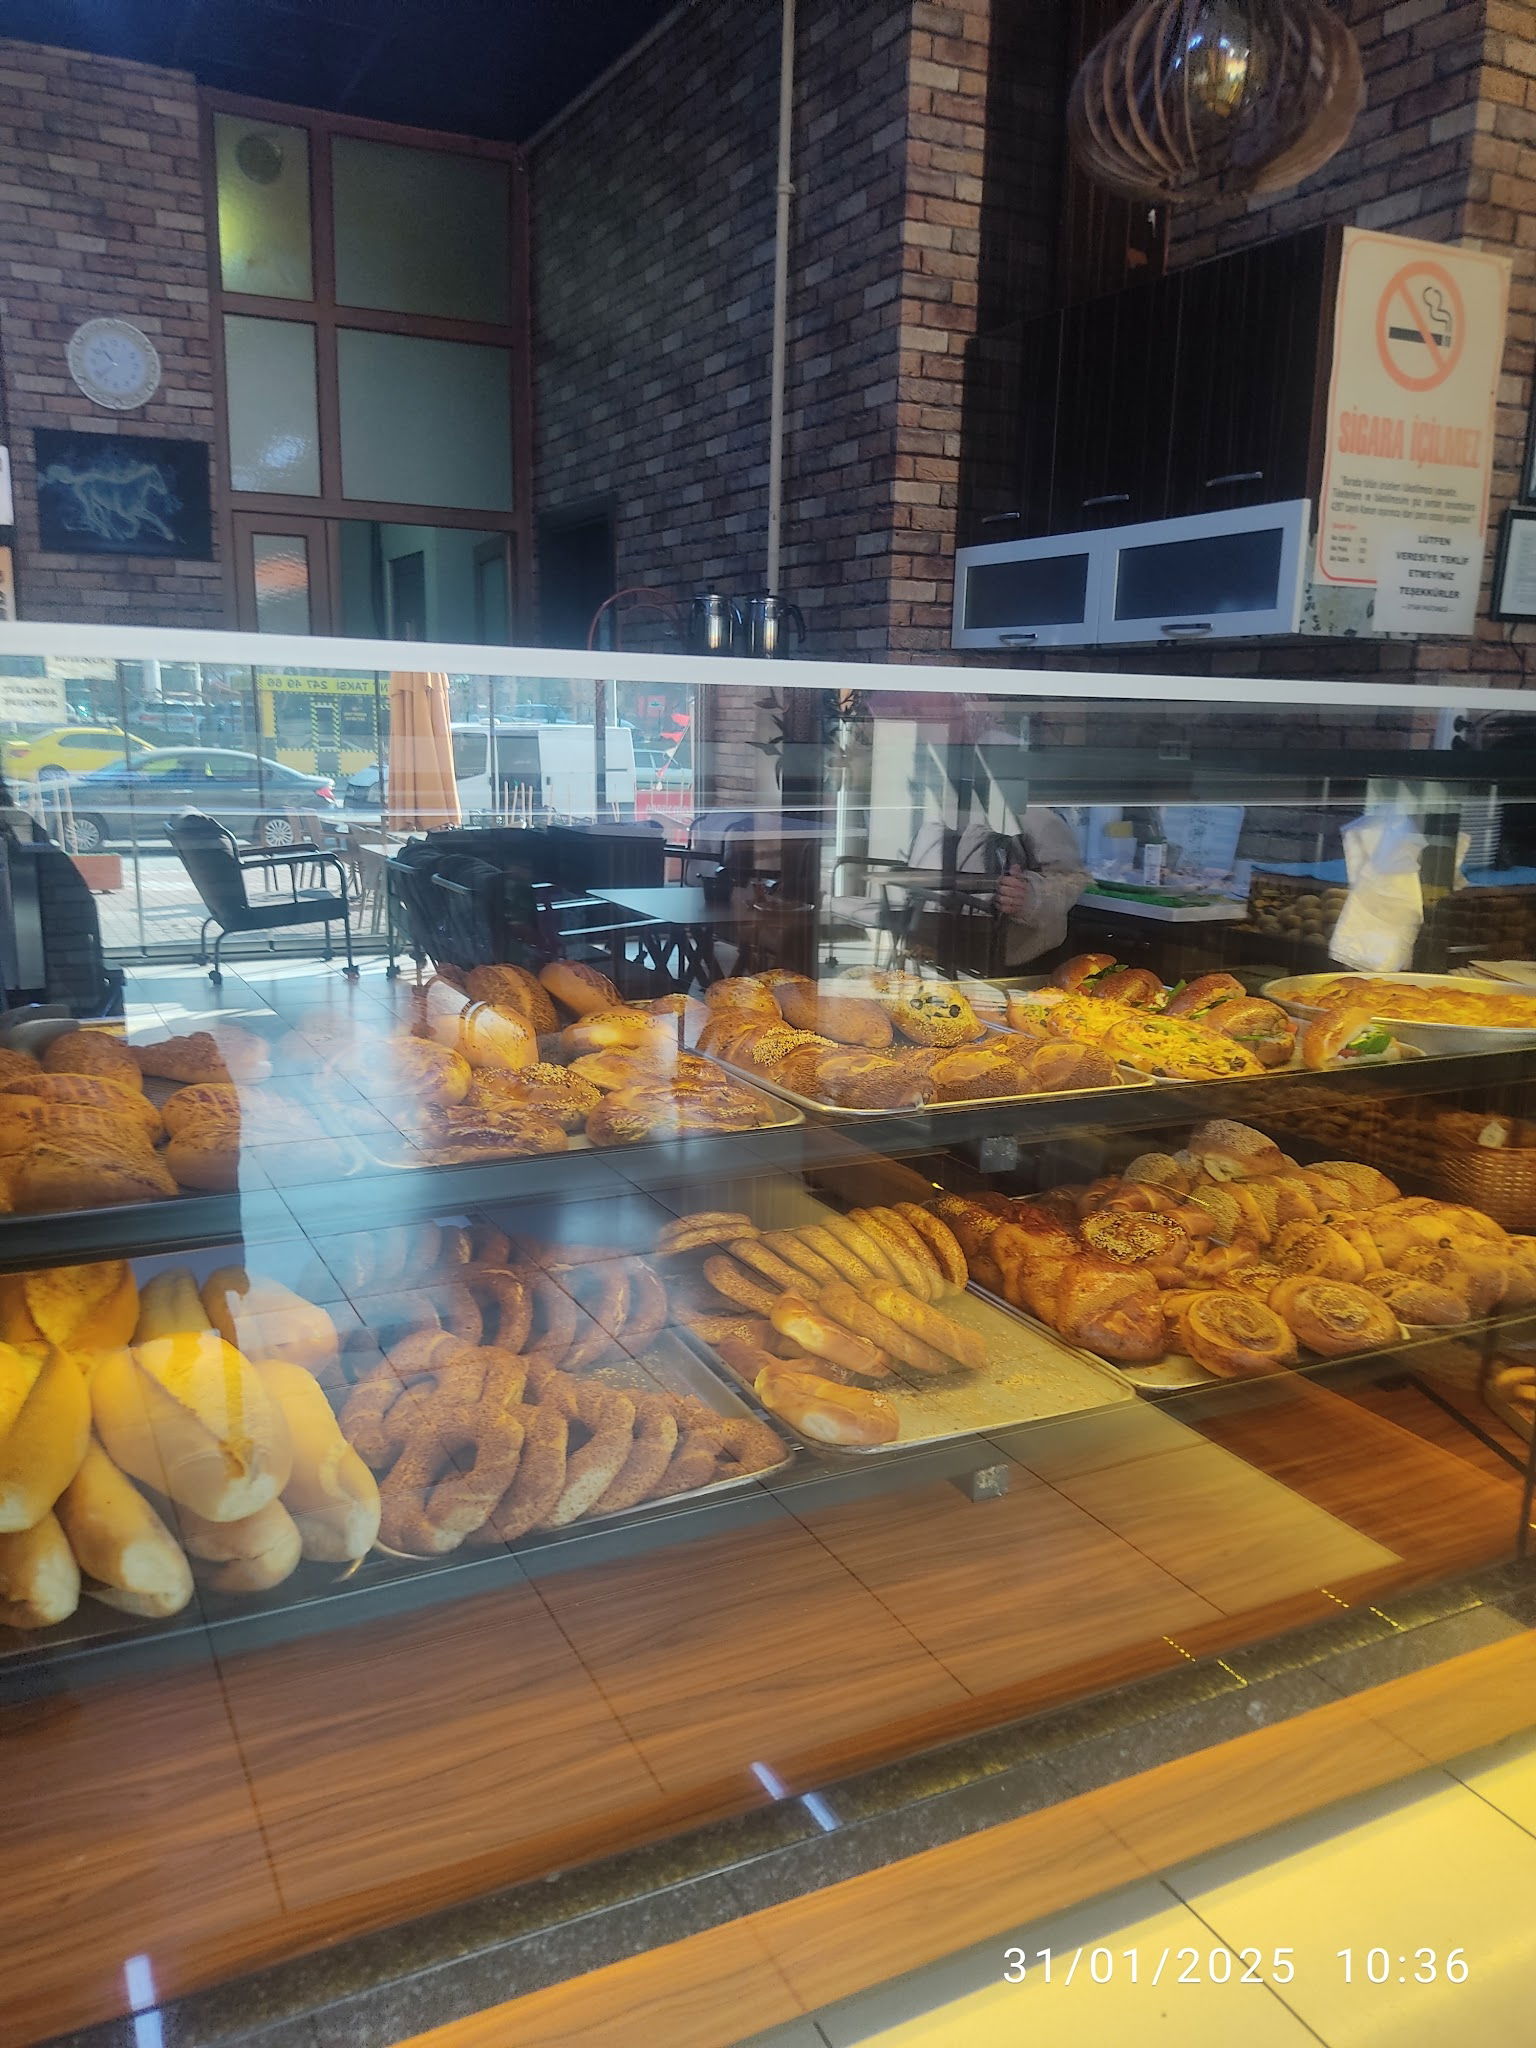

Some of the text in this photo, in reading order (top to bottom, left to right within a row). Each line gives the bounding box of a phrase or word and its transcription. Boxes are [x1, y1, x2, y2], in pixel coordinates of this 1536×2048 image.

[1338, 404, 1481, 469] SİGARA İÇİLMEZ
[1418, 534, 1452, 546] LÜTFEN
[1396, 551, 1469, 566] VERESİYE TEKLİF
[1400, 586, 1460, 600] TEŞEKKÜRLER
